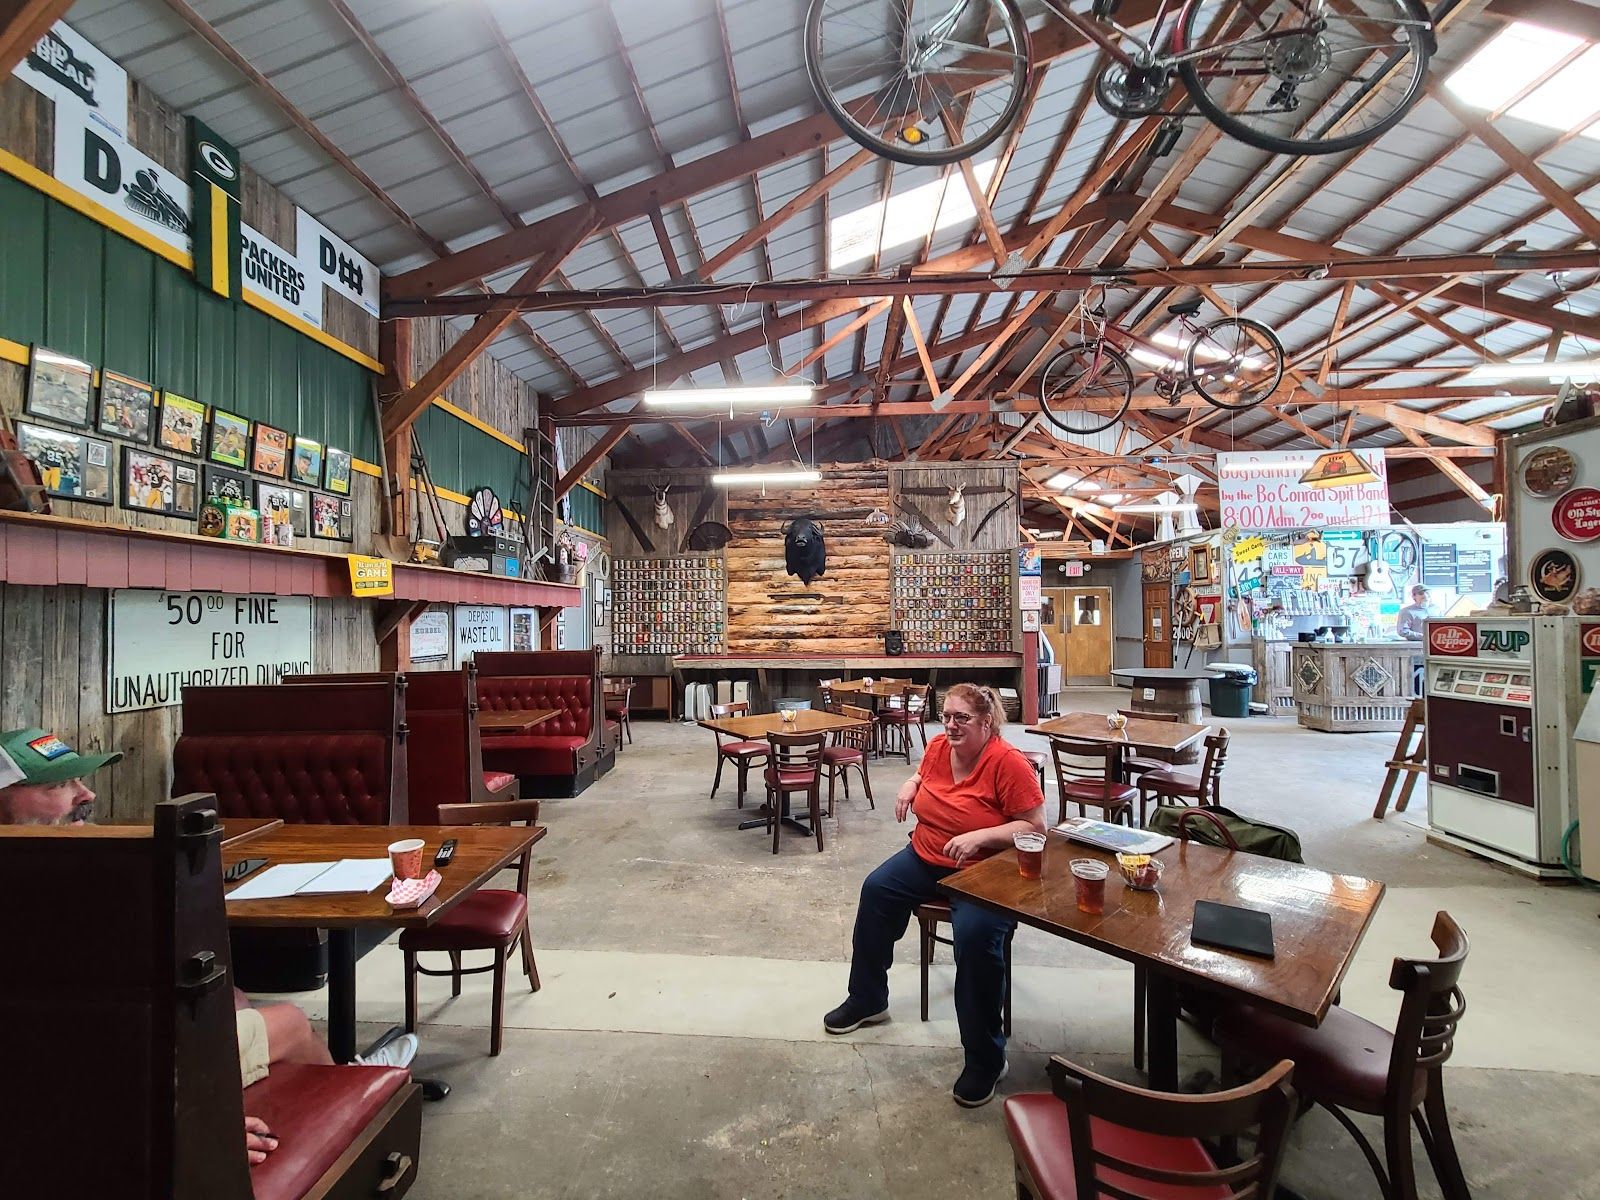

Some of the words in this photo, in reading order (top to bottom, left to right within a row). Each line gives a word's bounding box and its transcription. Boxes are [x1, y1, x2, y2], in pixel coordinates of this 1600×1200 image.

[241, 234, 305, 291] PACKERS
[245, 257, 300, 306] UNITED
[47, 450, 63, 463] 85
[1221, 490, 1234, 501] by
[1237, 490, 1253, 500] the
[1256, 484, 1276, 502] Bo
[1278, 483, 1325, 502] Conrad
[1328, 487, 1354, 504] Spit
[1357, 481, 1388, 500] Band
[1223, 505, 1263, 528] 8:00
[1266, 504, 1300, 527] Adm.
[1267, 552, 1288, 560] CARS
[1332, 547, 1361, 569] 57
[356, 568, 388, 578] GAME
[1274, 566, 1302, 574] ALL-WAY
[235, 597, 279, 625] FINE
[468, 610, 495, 623] DEPOSIT
[460, 627, 488, 644] WASTE
[489, 626, 502, 642] OIL
[1436, 633, 1471, 649] Pepper
[1447, 628, 1463, 639] Dr
[212, 631, 246, 661] FOR
